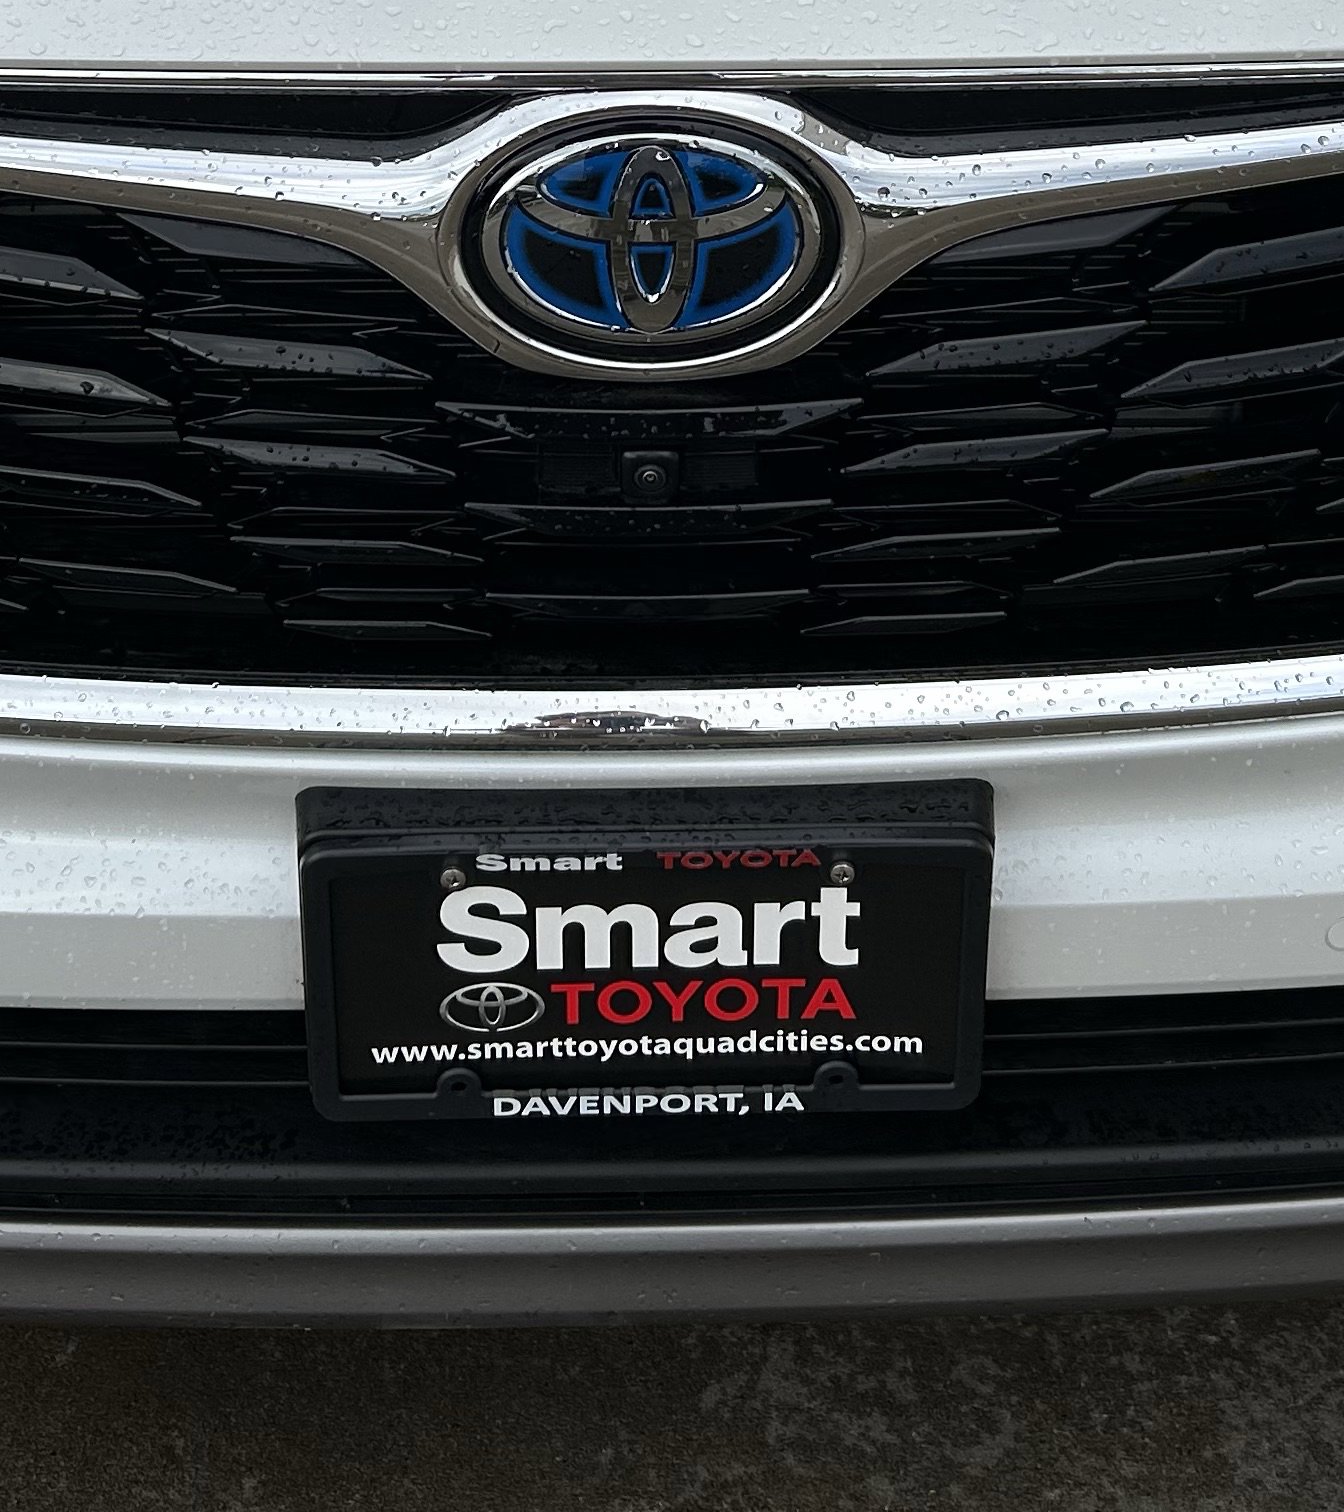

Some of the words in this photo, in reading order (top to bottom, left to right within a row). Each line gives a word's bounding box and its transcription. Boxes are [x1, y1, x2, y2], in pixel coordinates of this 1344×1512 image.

[475, 852, 623, 872] Smart
[656, 849, 822, 870] TOYOTA
[436, 886, 861, 974] Smart
[550, 977, 856, 1025] TOYOTA
[371, 1029, 923, 1064] www.smarttoyotaquadcities.com
[493, 1092, 750, 1116] DAVENPORT,
[764, 1091, 805, 1113] IA
